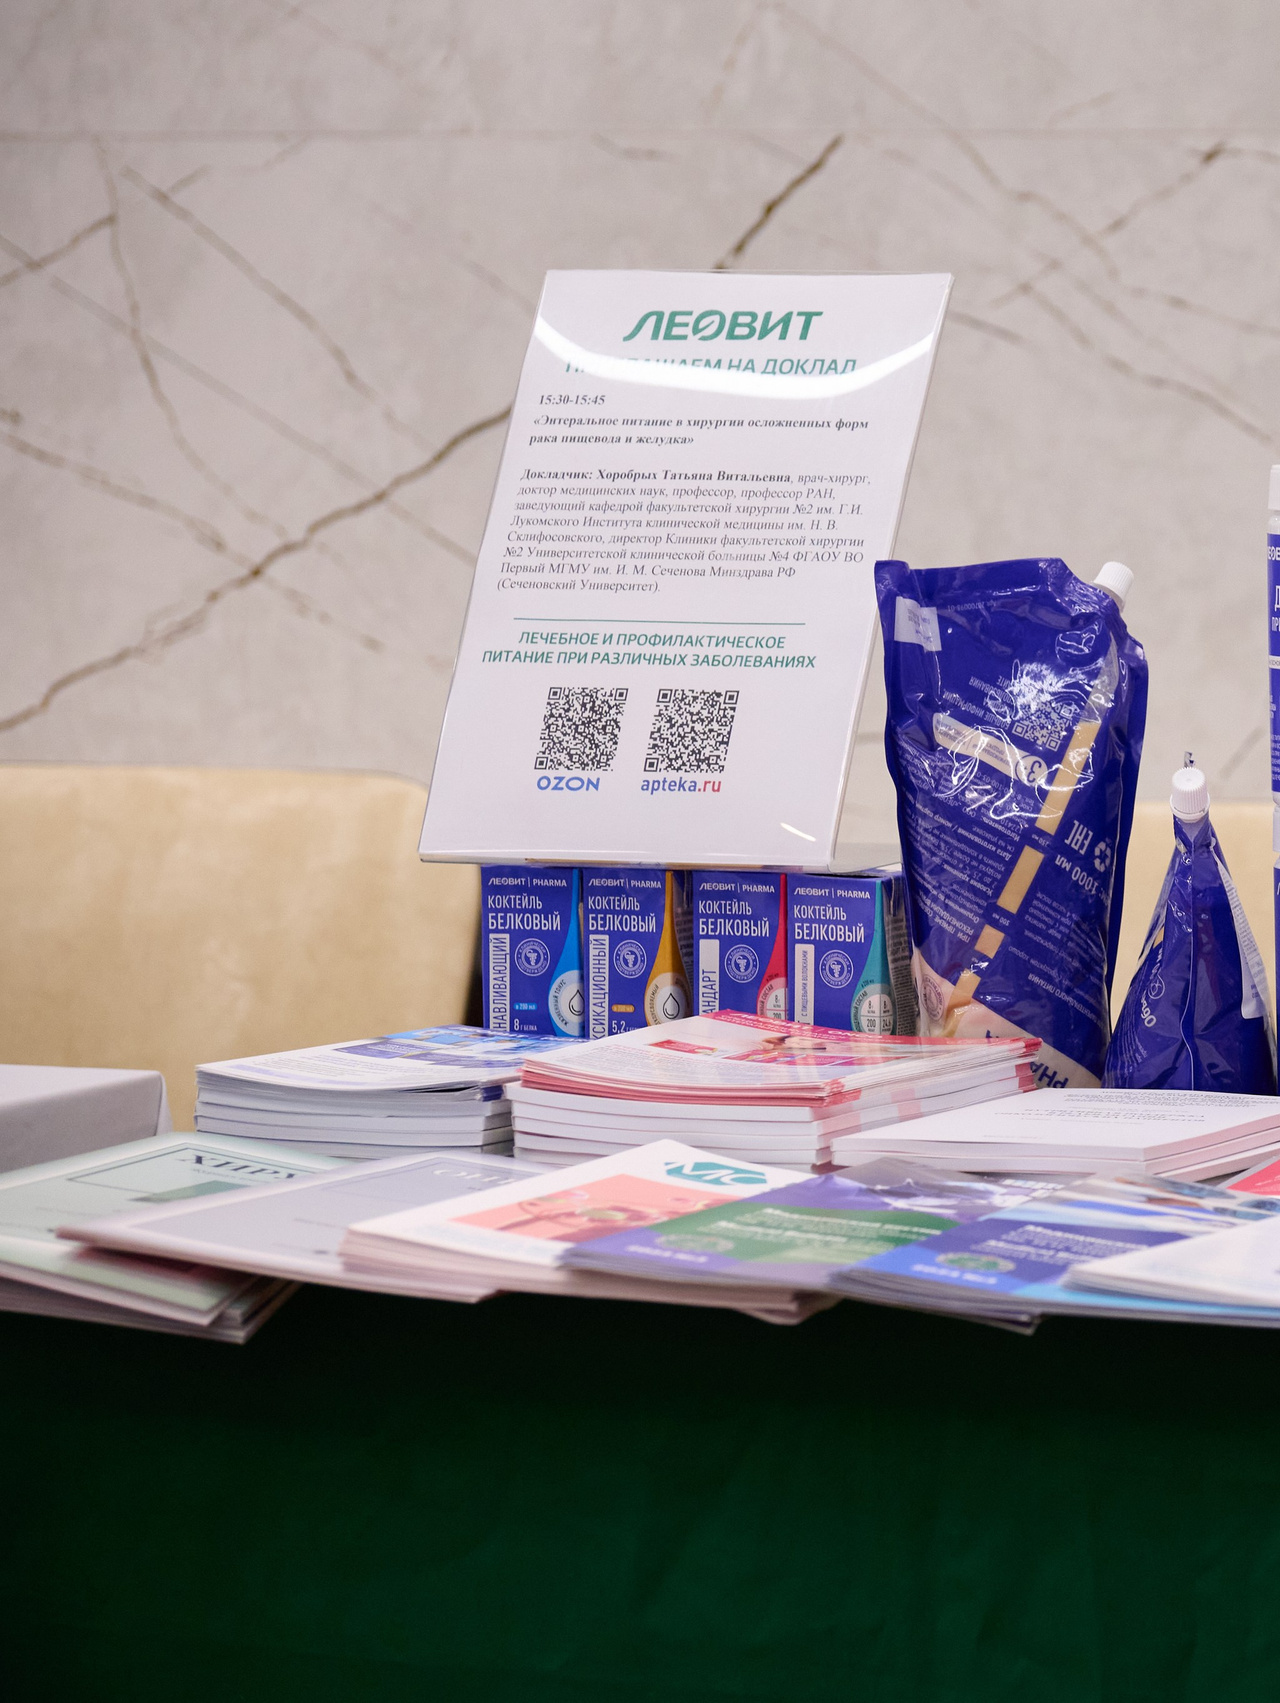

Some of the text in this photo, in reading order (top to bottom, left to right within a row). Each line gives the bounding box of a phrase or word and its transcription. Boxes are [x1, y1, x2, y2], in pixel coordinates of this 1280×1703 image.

[622, 310, 824, 342] ЛЕОВИТ
[727, 358, 756, 374] НА
[761, 357, 858, 376] ДОКЛАД
[539, 394, 607, 406] 15:30-15:45
[533, 414, 618, 427] «Энтеральное
[621, 418, 672, 426] питание
[687, 419, 744, 429] хирургии
[747, 419, 830, 428] осложненных
[835, 418, 868, 431] форм
[528, 435, 557, 445] рака
[561, 435, 621, 443] пищевода
[635, 436, 693, 446] желудка»
[520, 468, 870, 485] Докладчик: Хоробрых Татьяна Витальевна, врач-хирург,
[516, 485, 835, 501] доктор медицинских наук, профессор, профессор РАН,
[516, 500, 862, 516] заведующий кафедрой факультетской хирургии №2 им. Г.И.
[509, 515, 579, 528] Лукомского
[582, 516, 642, 530] Института
[645, 518, 720, 528] клинической
[723, 521, 784, 530] медицины
[810, 519, 821, 530] Н.
[826, 519, 837, 530] В.
[507, 530, 864, 549] Склифосовского, директор Клиники факультетской хирургии
[502, 546, 863, 562] №2 Университетской клинической больницы №4 ФГАОУ ВО
[500, 562, 795, 580] Первый МГМУ им. И. М. Сеченова Минздрава РФ
[496, 577, 659, 593] (Сеченовский Университет).
[518, 631, 786, 648] ЛЕЧЕБНОЕ И ПРОФИЛАКТИЧЕСКОЕ
[481, 650, 816, 668] ПИТАНИЕ ПРИ РАЗЛИЧНЫХ ЗАБОЛЕВАНИЯХ
[536, 775, 722, 796] OZON apteka.ru
[488, 877, 568, 887] ЛЕОВИТ PHARMA
[488, 893, 543, 909] КОКТЕЙЛЬ
[794, 887, 871, 899] ЛЕОВИТ PHARMA
[488, 911, 561, 931] БЕЛКОВЫЙ
[794, 904, 847, 921] КОКТЕЙЛЬ
[795, 922, 865, 943] БЕЛКОВЫЙ
